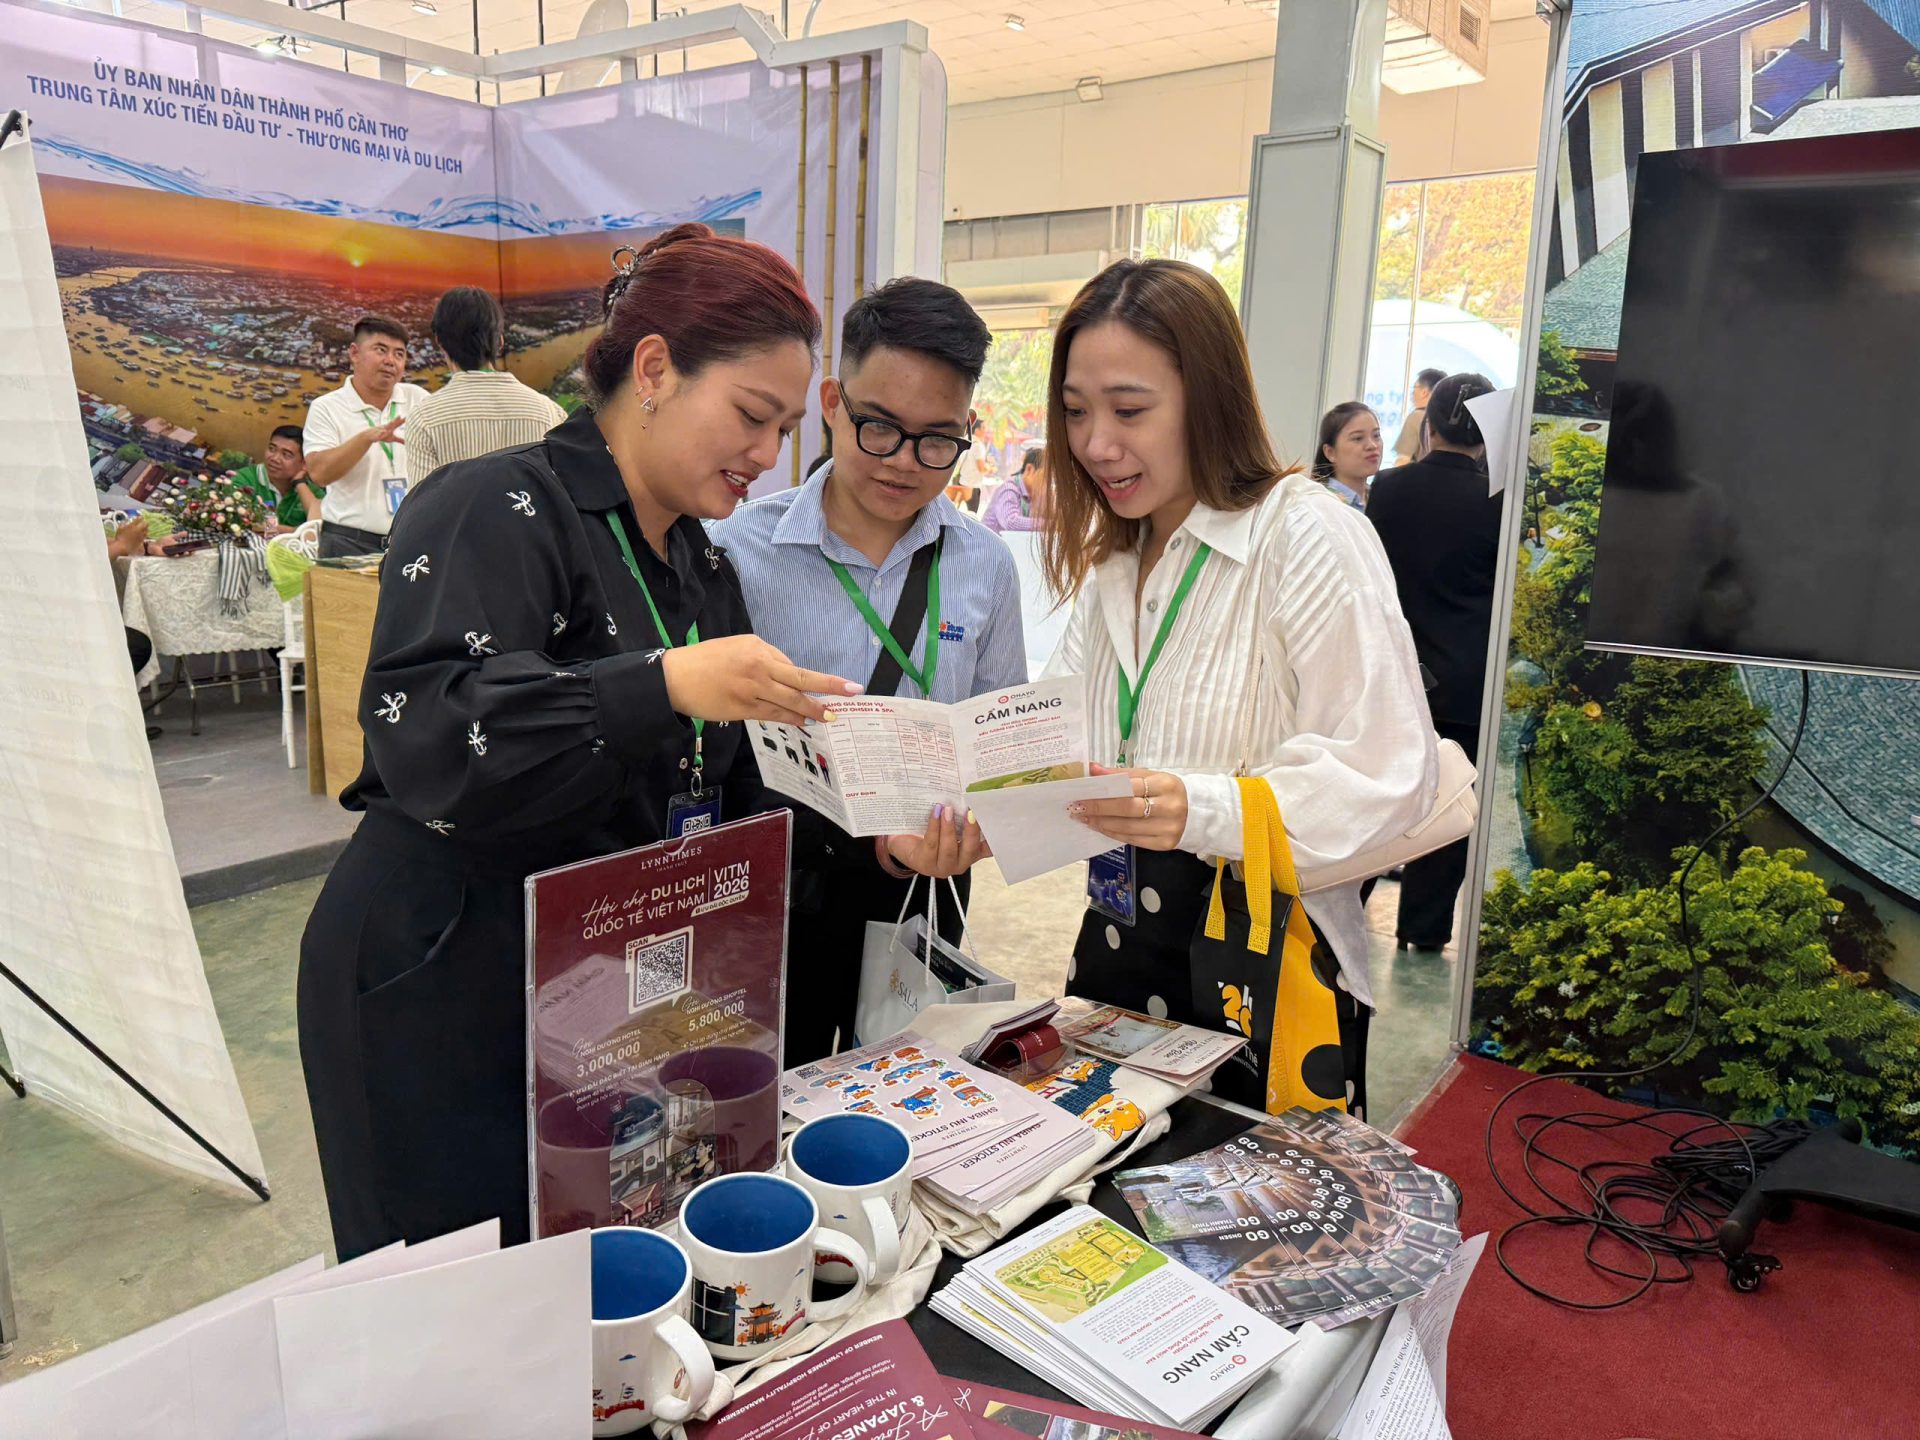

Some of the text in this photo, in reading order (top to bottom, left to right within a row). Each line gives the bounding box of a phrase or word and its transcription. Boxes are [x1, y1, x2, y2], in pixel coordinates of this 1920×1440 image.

[94, 56, 409, 141] ỦY BAN NHÂN DÂN THÀNH PHỐ CẦN THƠ
[27, 75, 93, 104] TRUNG
[97, 87, 137, 112] TÂM
[142, 96, 176, 119] XÚC
[180, 103, 217, 127] TIẾN
[222, 109, 255, 133] ĐẦU
[258, 120, 281, 139] TƯ
[297, 128, 361, 155] THƯƠNG
[365, 141, 390, 162] MẠI
[393, 146, 410, 165] VÀ
[415, 152, 431, 168] DU
[434, 155, 462, 174] LỊCH
[1010, 690, 1036, 699] OHAYO
[1015, 697, 1062, 715] NANG
[641, 846, 703, 871] LYNNTIMES
[714, 860, 750, 883] VITM
[651, 884, 671, 901] DU
[675, 874, 705, 895] LỊCH
[713, 875, 750, 899] 2026
[583, 892, 705, 940] QUỐC TẾ VIỆT NAM
[628, 937, 649, 950] SCAN
[688, 1000, 745, 1032] 5,800,000
[621, 1029, 641, 1042] HOTEL
[910, 1106, 999, 1143] SHIBA INU STICKE
[1224, 1144, 1245, 1157] GO
[1238, 1136, 1259, 1150] GO
[961, 1144, 1000, 1169] STICKER
[1237, 1216, 1260, 1227] GO
[1275, 1208, 1299, 1221] GO
[1245, 1230, 1270, 1241] GO
[1290, 1221, 1314, 1234] GO
[1209, 1325, 1250, 1353] CẨM
[1163, 1348, 1215, 1384] NANG
[1210, 1363, 1236, 1381] OHAYO
[717, 1334, 884, 1425] MEMBER OF LYNNTIMES HOSPITALITY MANAGEMENT
[865, 1393, 886, 1408] THE
[885, 1388, 897, 1398] IN
[911, 1395, 924, 1407] &
[831, 1401, 908, 1440] JAPANES
[833, 1402, 865, 1425] HEART
[817, 1422, 832, 1434] OF
